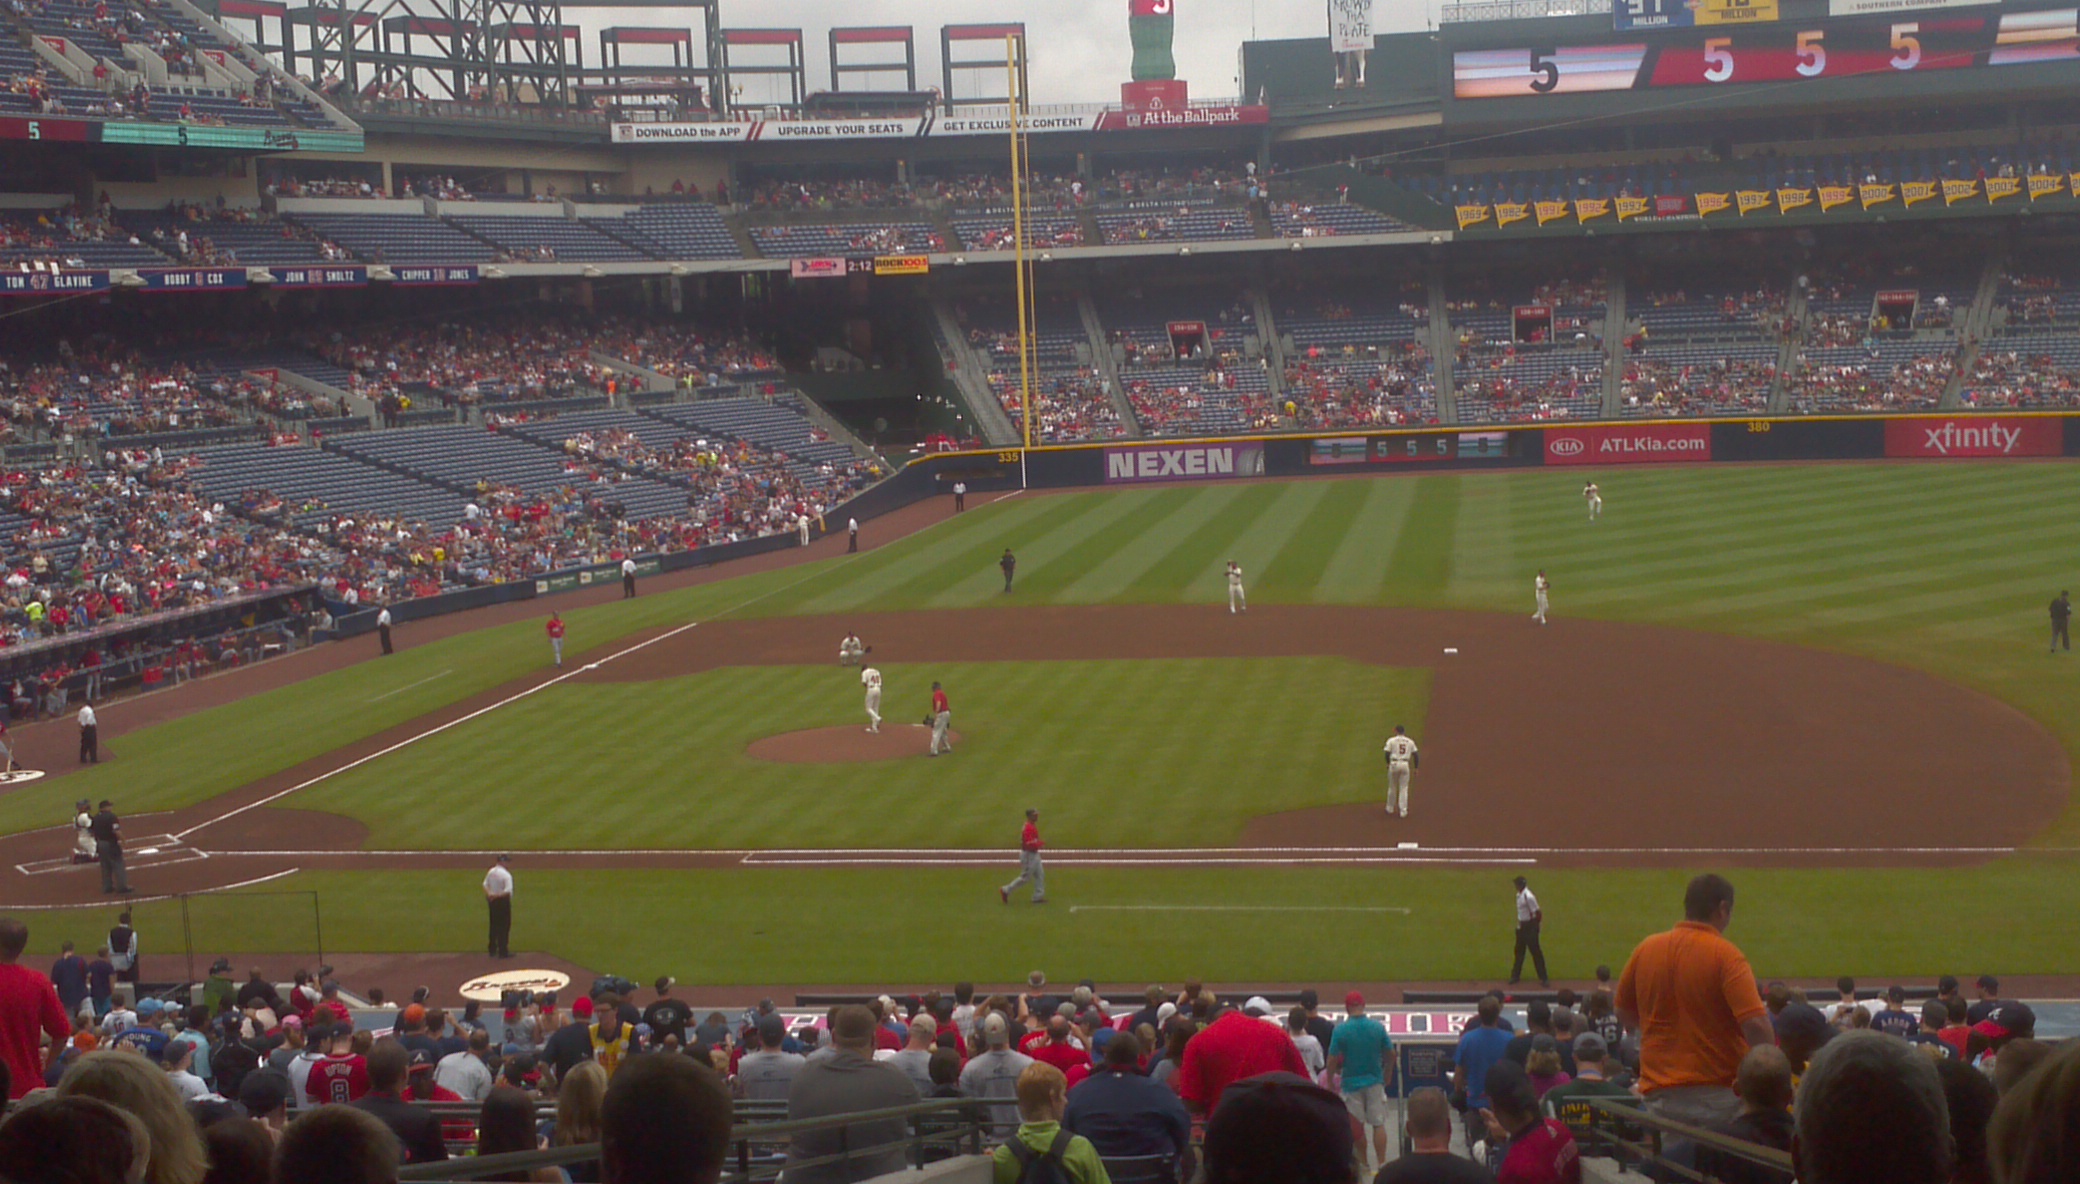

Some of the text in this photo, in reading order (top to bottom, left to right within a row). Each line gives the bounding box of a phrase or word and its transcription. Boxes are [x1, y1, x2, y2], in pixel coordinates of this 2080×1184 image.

[1856, 1, 1903, 10] SOUTHERN
[1632, 15, 1669, 27] MILLION
[1720, 9, 1757, 20] MILLION
[1338, 22, 1370, 38] PLATE
[1703, 22, 1920, 82] 5 5 5
[1529, 48, 1559, 92] 5
[1160, 109, 1182, 124] the
[1183, 107, 1240, 125] Ballpark
[28, 120, 40, 141] 5
[778, 122, 904, 137] UPGRADE YOUR SEATS
[943, 116, 1084, 132] GET EXCLUSVE CONTENT
[635, 126, 741, 139] DOWNLOAD the APP
[1903, 185, 1930, 198] 2001
[1944, 183, 1972, 196] 2002
[1986, 181, 2014, 194] 2003
[2029, 179, 2057, 192] 2004
[1779, 192, 1804, 205] 1998
[1820, 190, 1846, 203] 1999
[1861, 187, 1888, 200] 2000
[1618, 200, 1642, 212] 1993
[1698, 196, 1723, 209] 1996
[1738, 194, 1763, 207] 1997
[1458, 208, 1482, 221] 1969
[1497, 206, 1522, 219] 1982
[1538, 204, 1562, 217] 1991
[1577, 202, 1602, 215] 1992
[848, 260, 872, 272] 2:12
[164, 273, 190, 286] BOBBY
[207, 272, 223, 285] COX
[285, 271, 305, 283] JOHN
[402, 269, 430, 281] CHIPPER
[449, 268, 469, 281] JONES
[6, 276, 25, 289] TOM
[53, 275, 93, 288] GLAVINE
[1747, 421, 1770, 433] 380
[1924, 421, 2021, 454] xfinity
[1377, 438, 1448, 457] 5 5 5
[1554, 437, 1705, 453] KIA ATLKia.com
[998, 451, 1020, 463] 335
[1109, 447, 1233, 479] NEXEN
[1398, 743, 1407, 755] 5
[324, 1061, 353, 1078] UPTON
